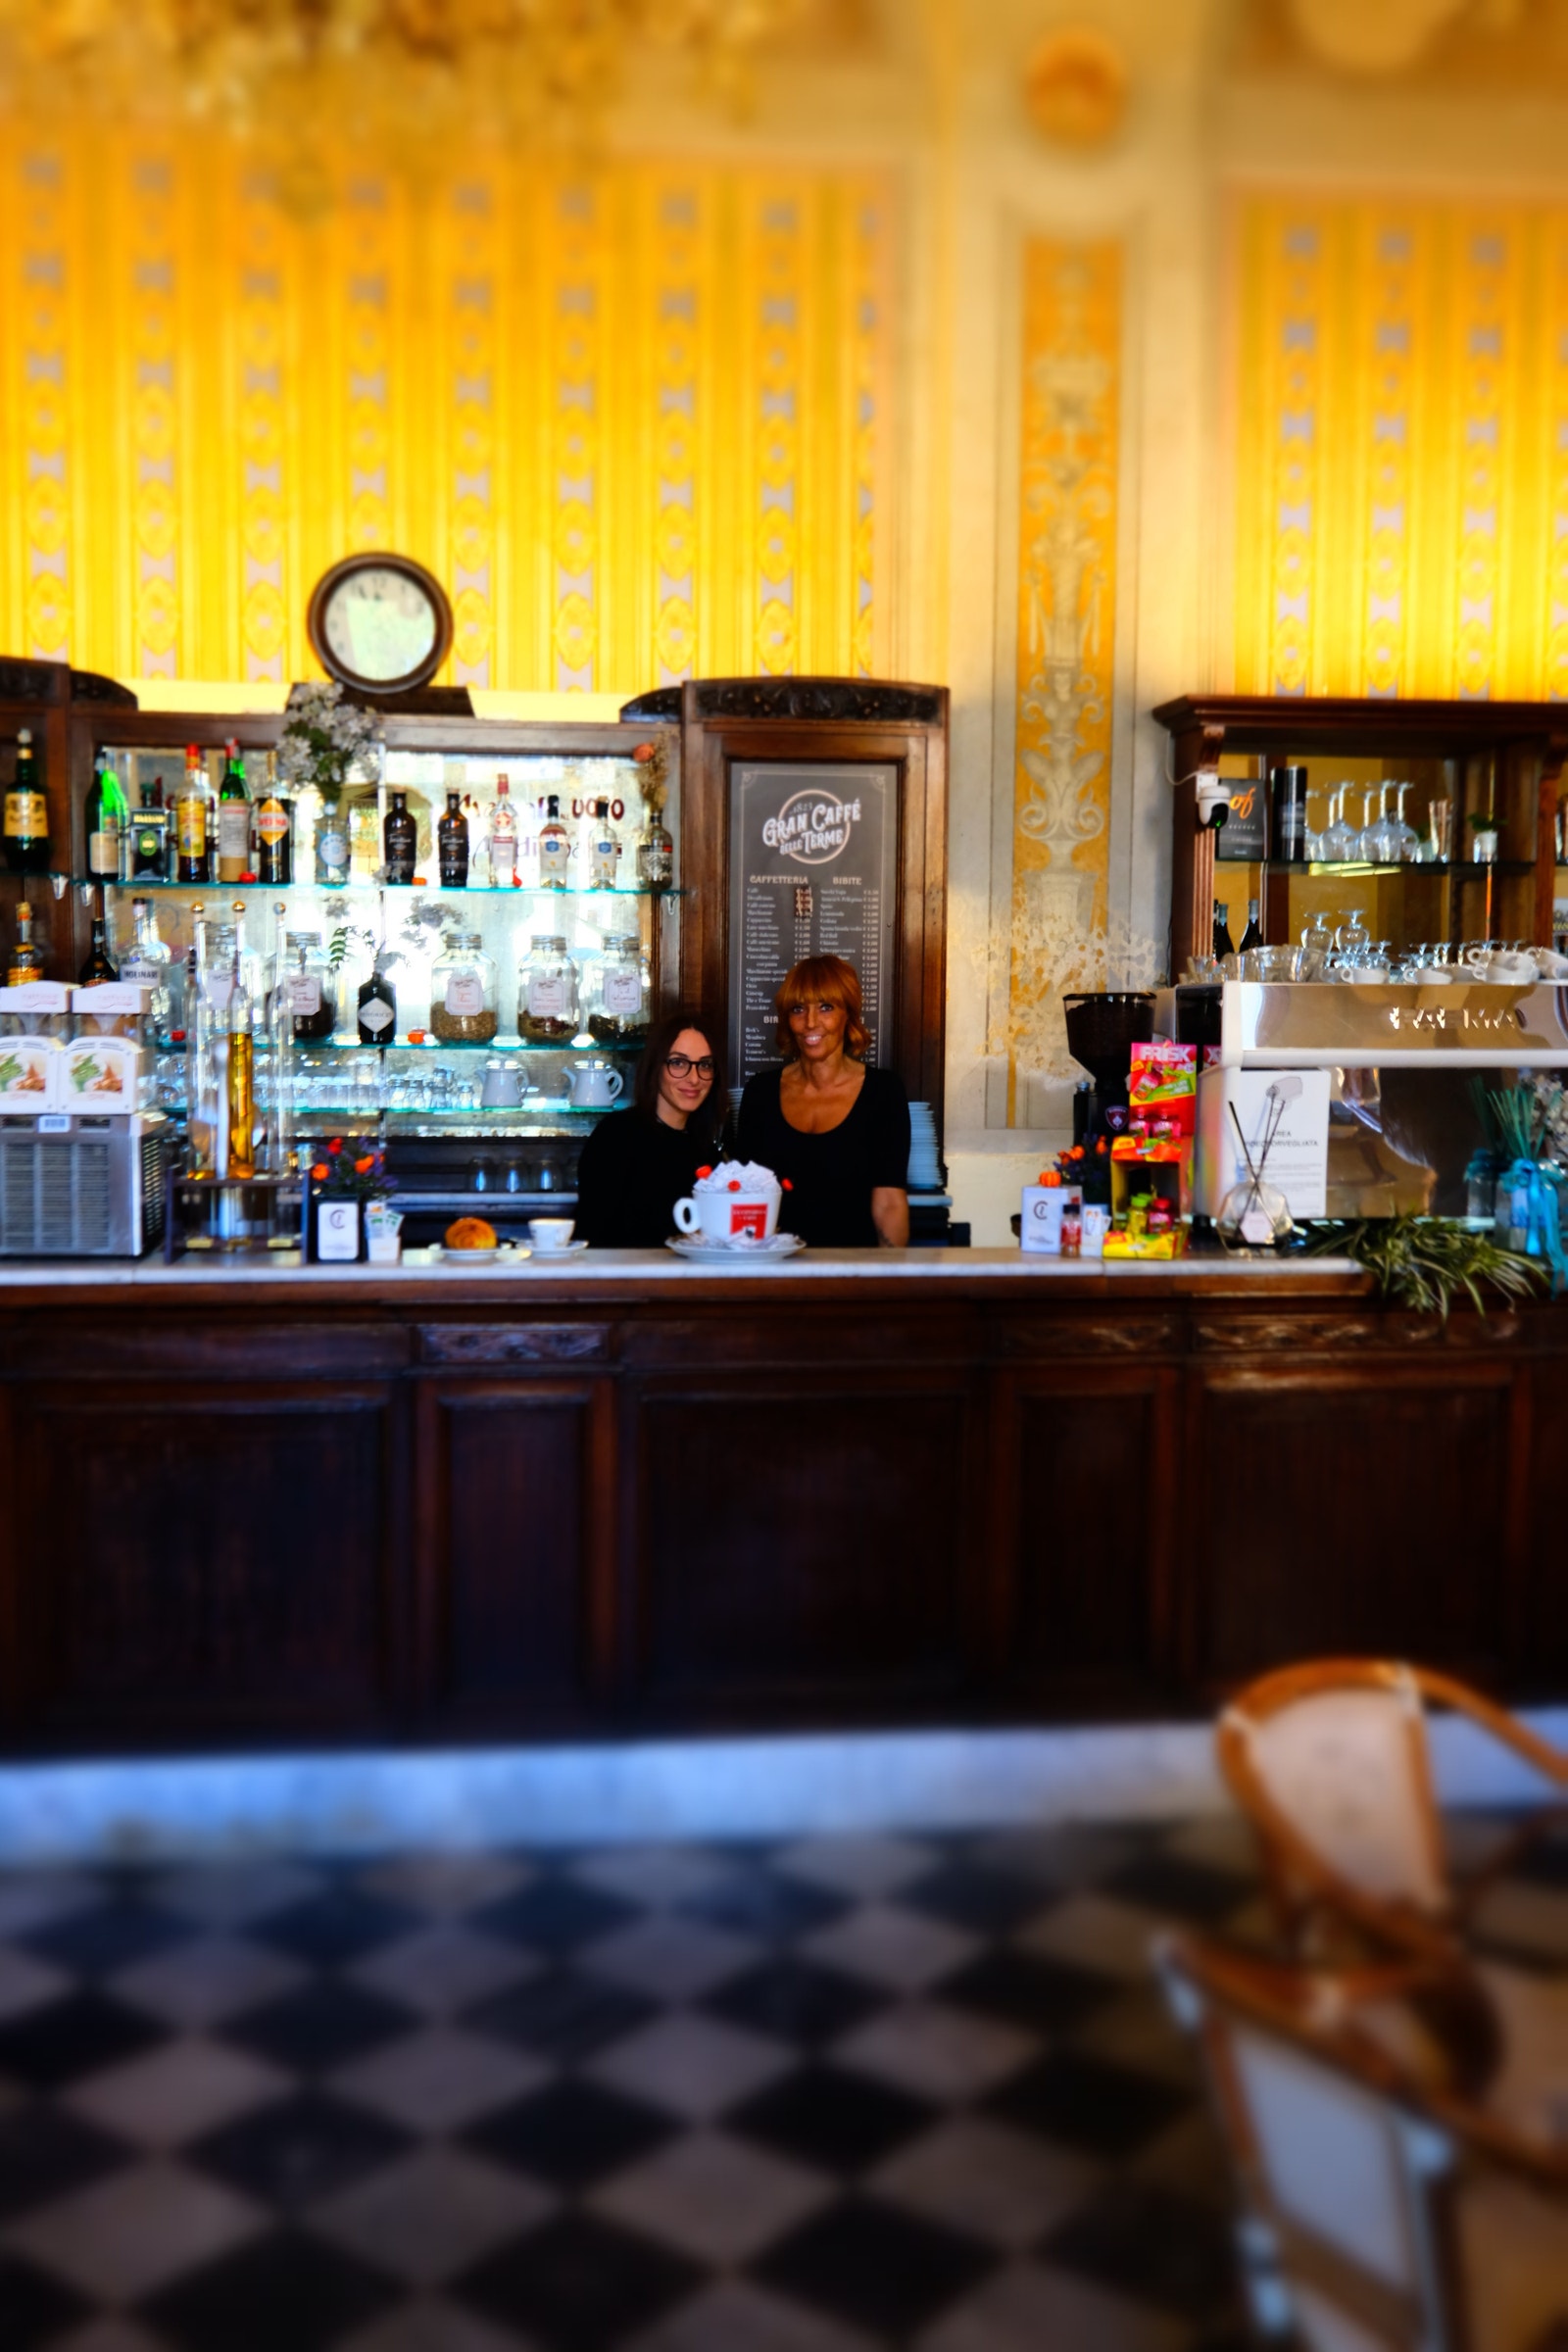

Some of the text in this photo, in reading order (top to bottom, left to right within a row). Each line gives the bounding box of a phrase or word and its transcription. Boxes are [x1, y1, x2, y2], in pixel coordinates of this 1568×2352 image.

[762, 812, 808, 848] GRAN
[779, 828, 845, 856] DELLE TERME
[750, 875, 808, 884] CAFFETTERIA
[763, 1015, 779, 1024] BIR
[1140, 1046, 1192, 1062] FRISK
